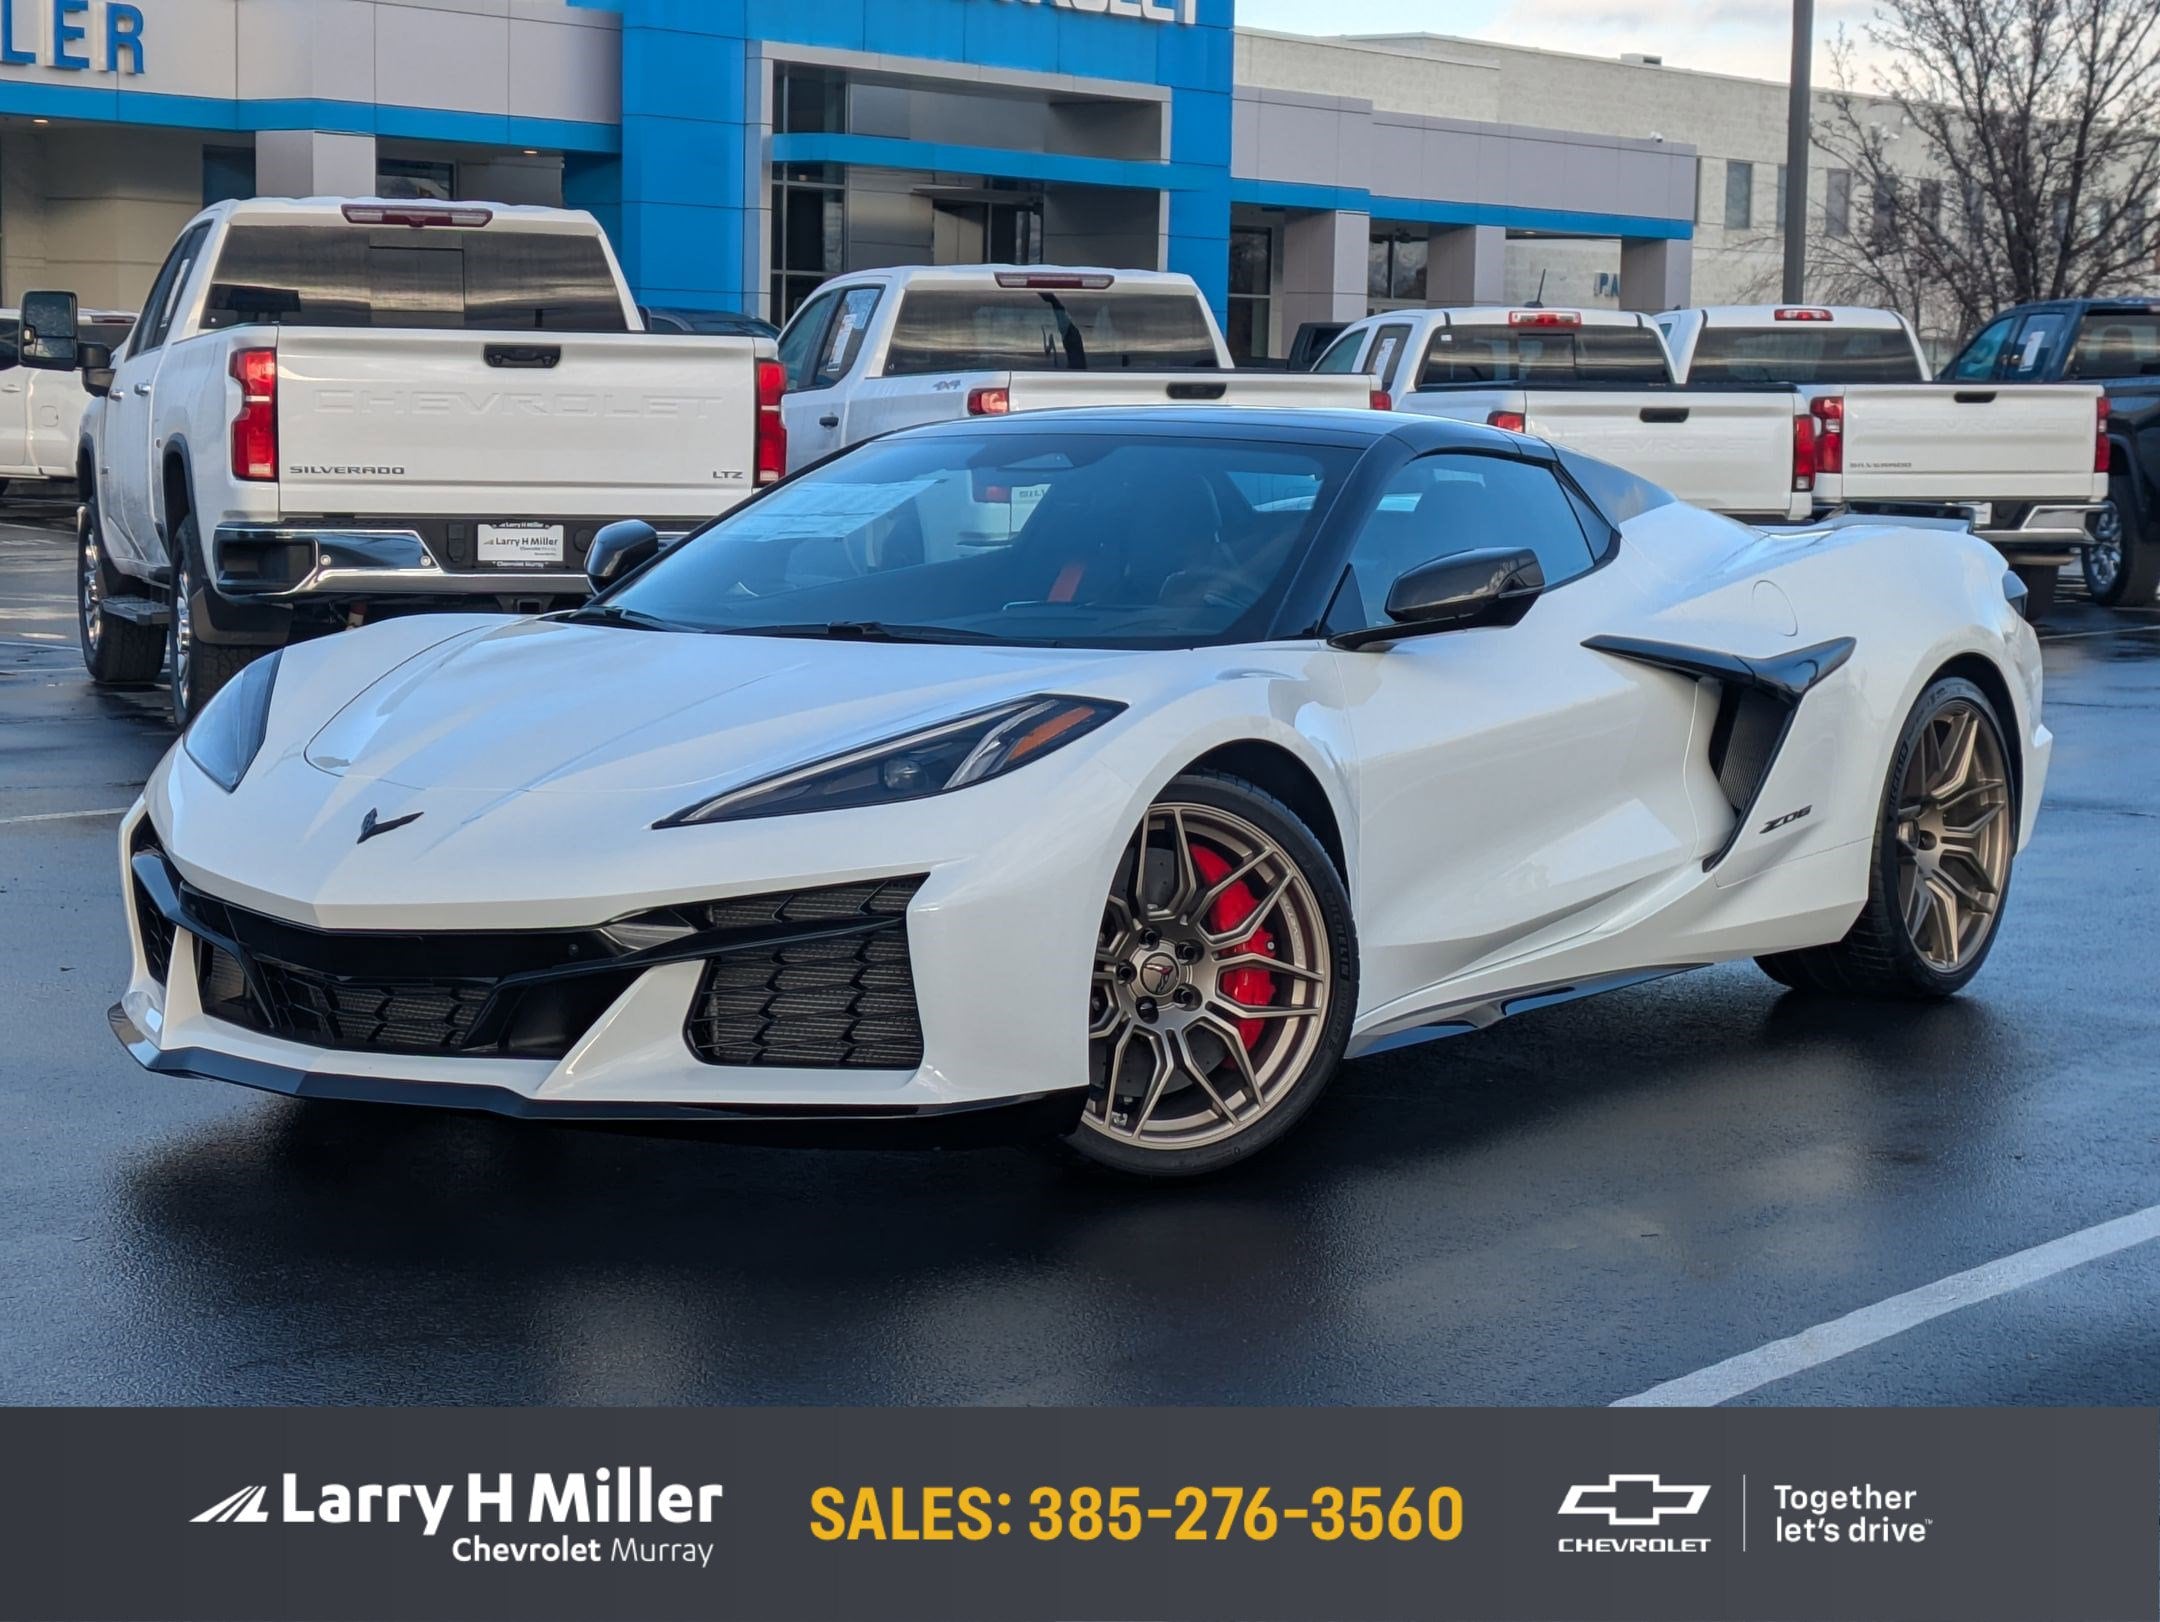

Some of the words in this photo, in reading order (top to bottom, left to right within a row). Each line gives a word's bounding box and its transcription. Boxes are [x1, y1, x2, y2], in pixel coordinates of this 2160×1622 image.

[1, 0, 145, 74] LER
[313, 389, 723, 420] CHEVROLET
[289, 465, 405, 475] SILVERADO
[712, 470, 743, 480] LTZ
[495, 537, 520, 547] Larry
[522, 537, 529, 545] H
[530, 536, 558, 546] Miller
